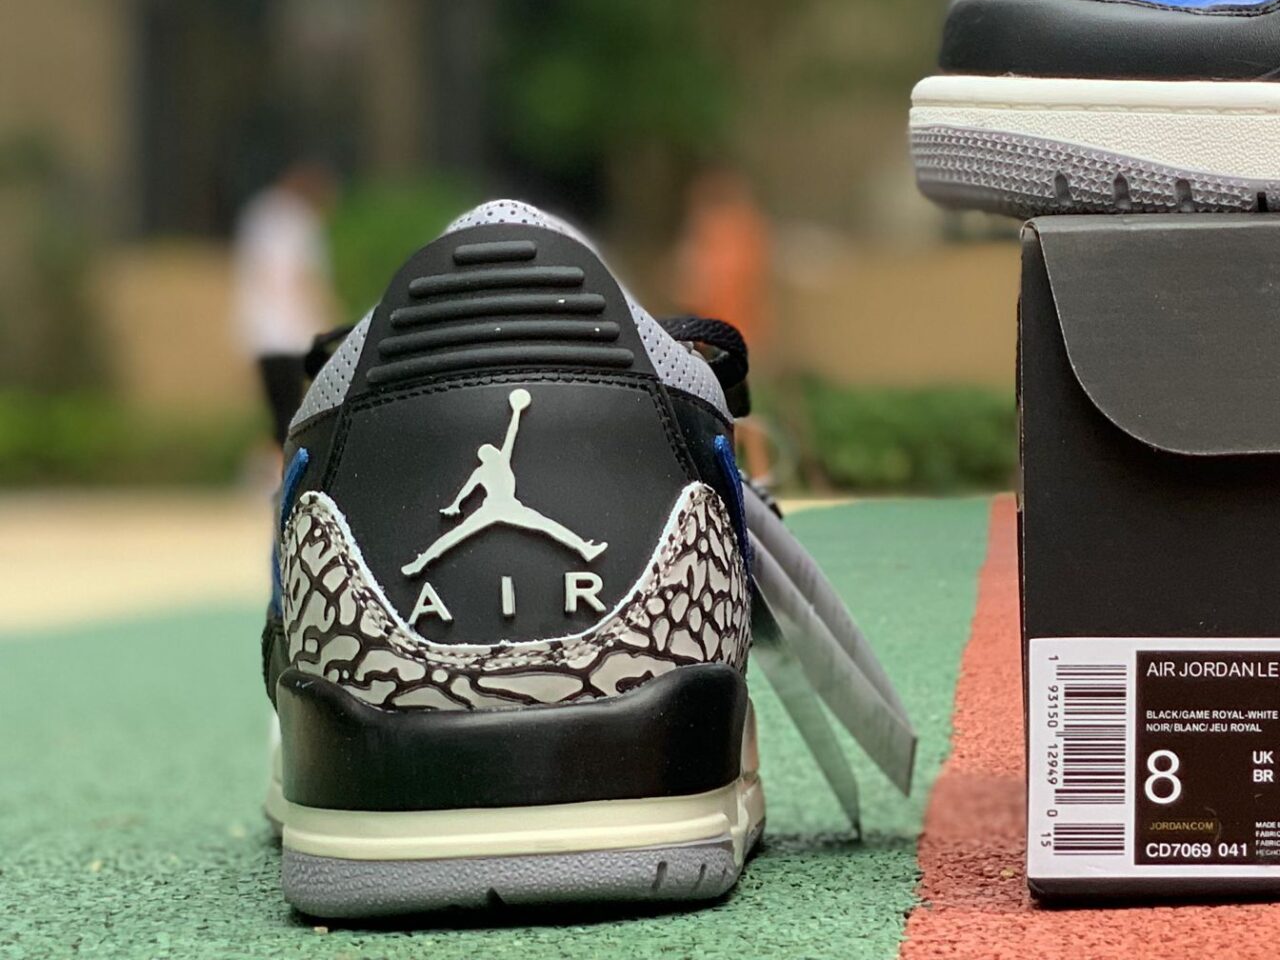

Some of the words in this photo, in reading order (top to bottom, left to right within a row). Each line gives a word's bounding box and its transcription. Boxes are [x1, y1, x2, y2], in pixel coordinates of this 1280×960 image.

[407, 572, 607, 624] AIR
[1146, 661, 1176, 678] AIR
[1179, 661, 1254, 678] JORDAN
[1047, 685, 1059, 728] 93150
[1146, 710, 1210, 720] BLACK/GAME
[1211, 710, 1279, 720] ROYAL-WHITE
[1230, 722, 1262, 733] ROYAL
[1047, 743, 1058, 785] 12949
[1252, 750, 1274, 764] UK
[1144, 749, 1182, 805] 8
[1253, 769, 1274, 783] BR
[1046, 808, 1058, 818] 0
[1255, 821, 1276, 829] MADE
[1040, 832, 1052, 848] 15
[1145, 843, 1212, 858] CD7069
[1218, 843, 1247, 858] 041
